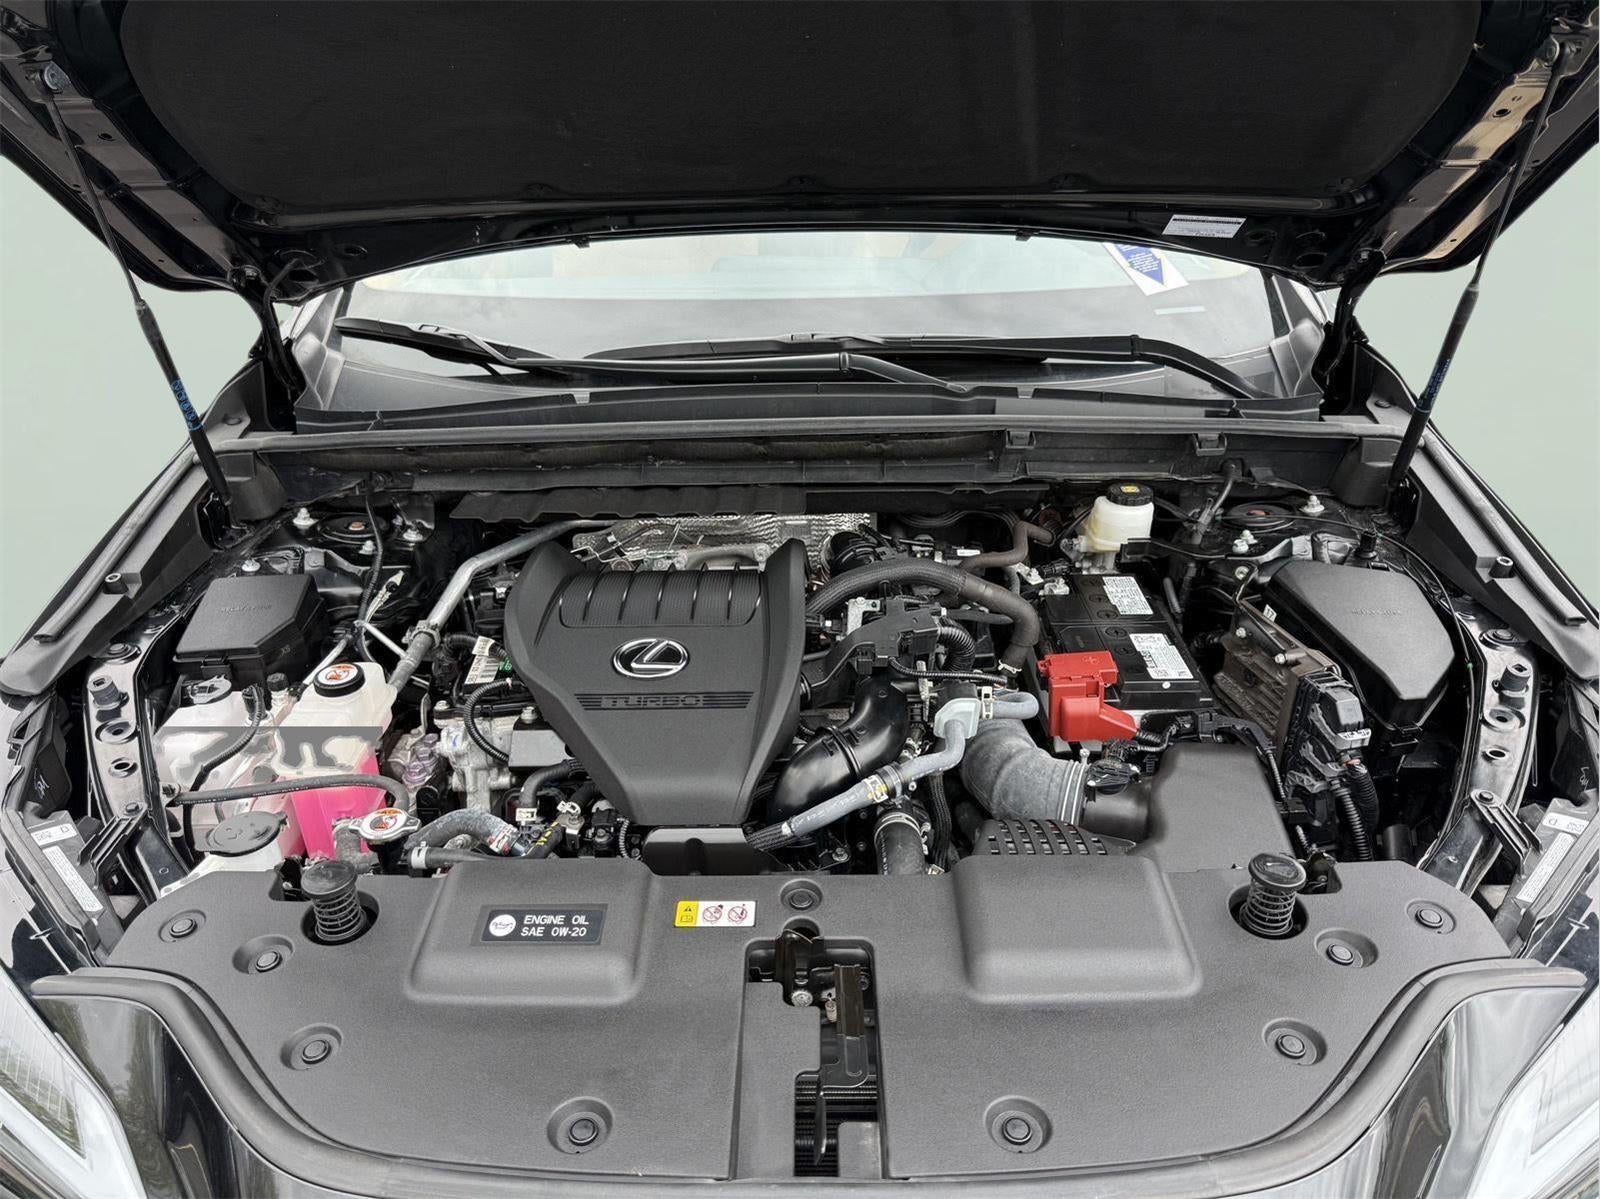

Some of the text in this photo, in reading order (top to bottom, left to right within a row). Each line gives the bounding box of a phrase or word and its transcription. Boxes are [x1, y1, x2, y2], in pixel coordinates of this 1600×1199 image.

[602, 695, 702, 709] TURBO
[523, 914, 590, 925] ENGINE OIL
[520, 926, 588, 937] SAE 0W-20
